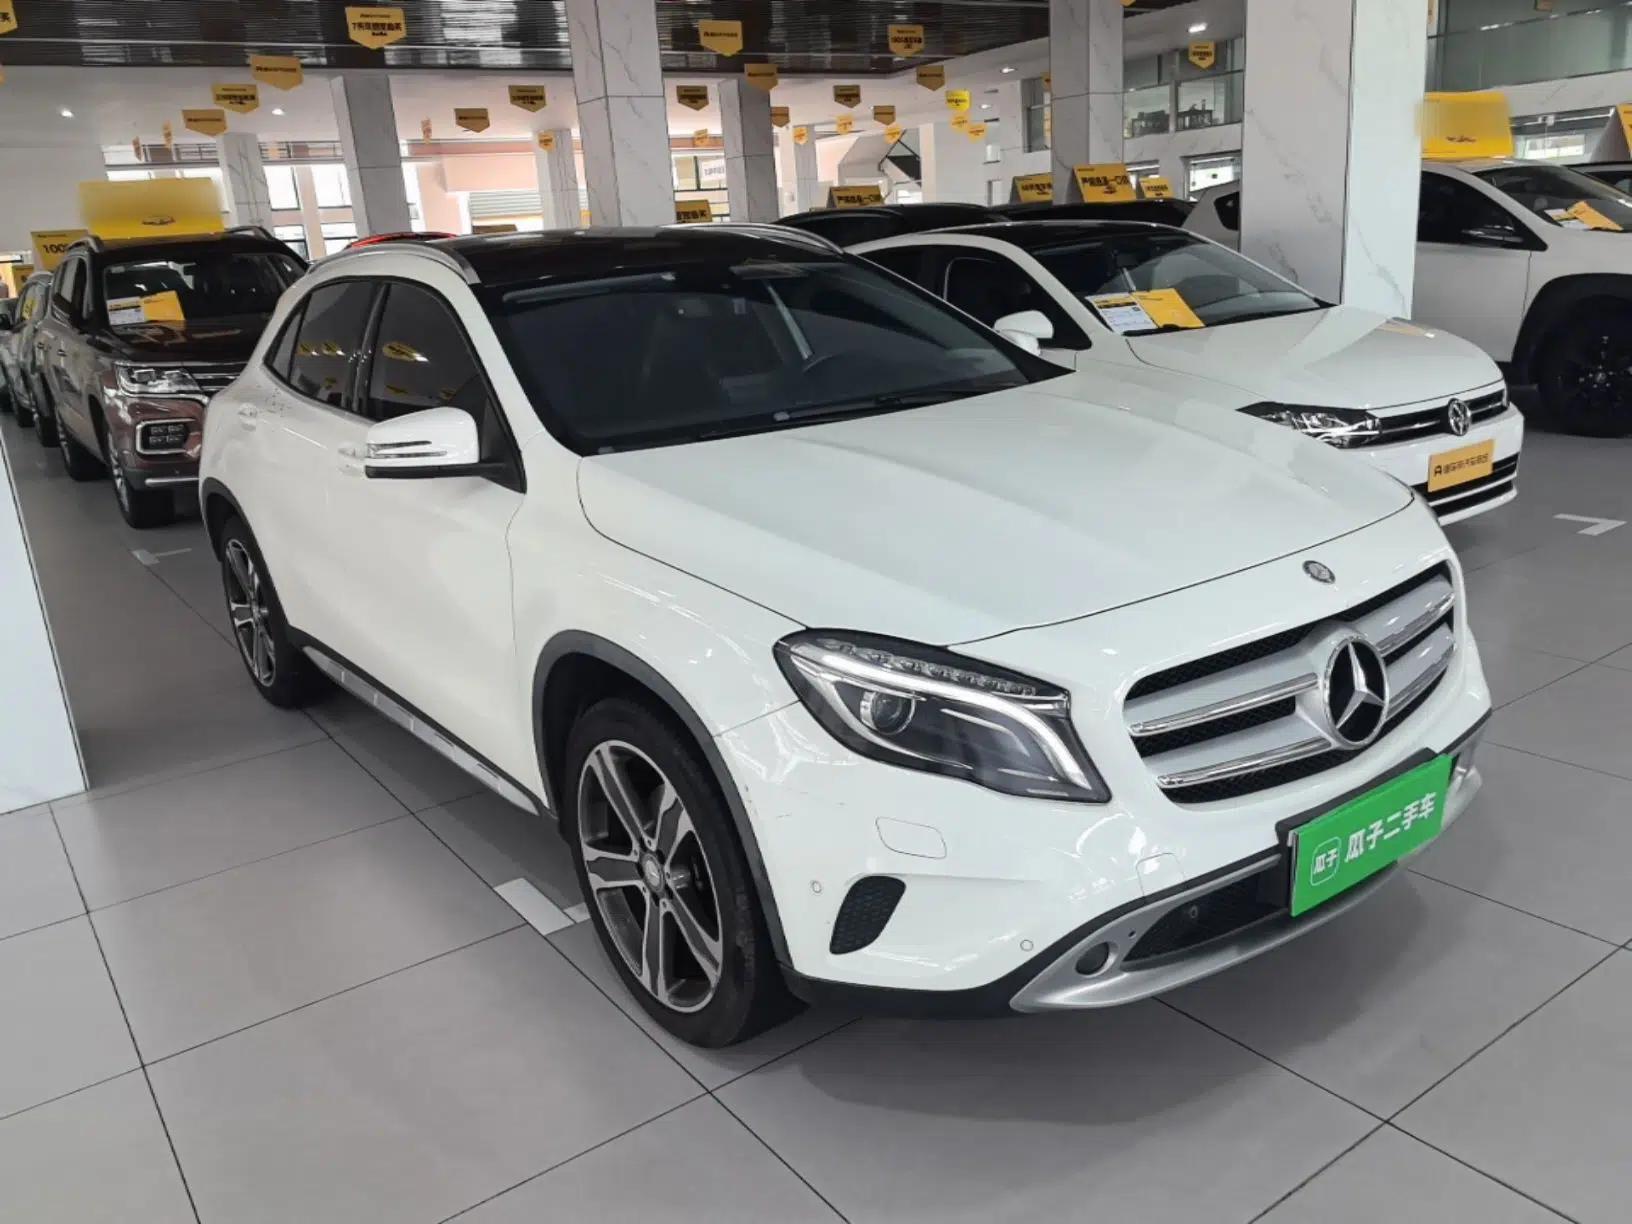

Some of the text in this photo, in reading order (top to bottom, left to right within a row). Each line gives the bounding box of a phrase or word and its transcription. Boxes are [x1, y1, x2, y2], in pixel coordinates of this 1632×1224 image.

[1345, 792, 1437, 863] 瓜子二手车
[1313, 848, 1338, 875] 瓜子
